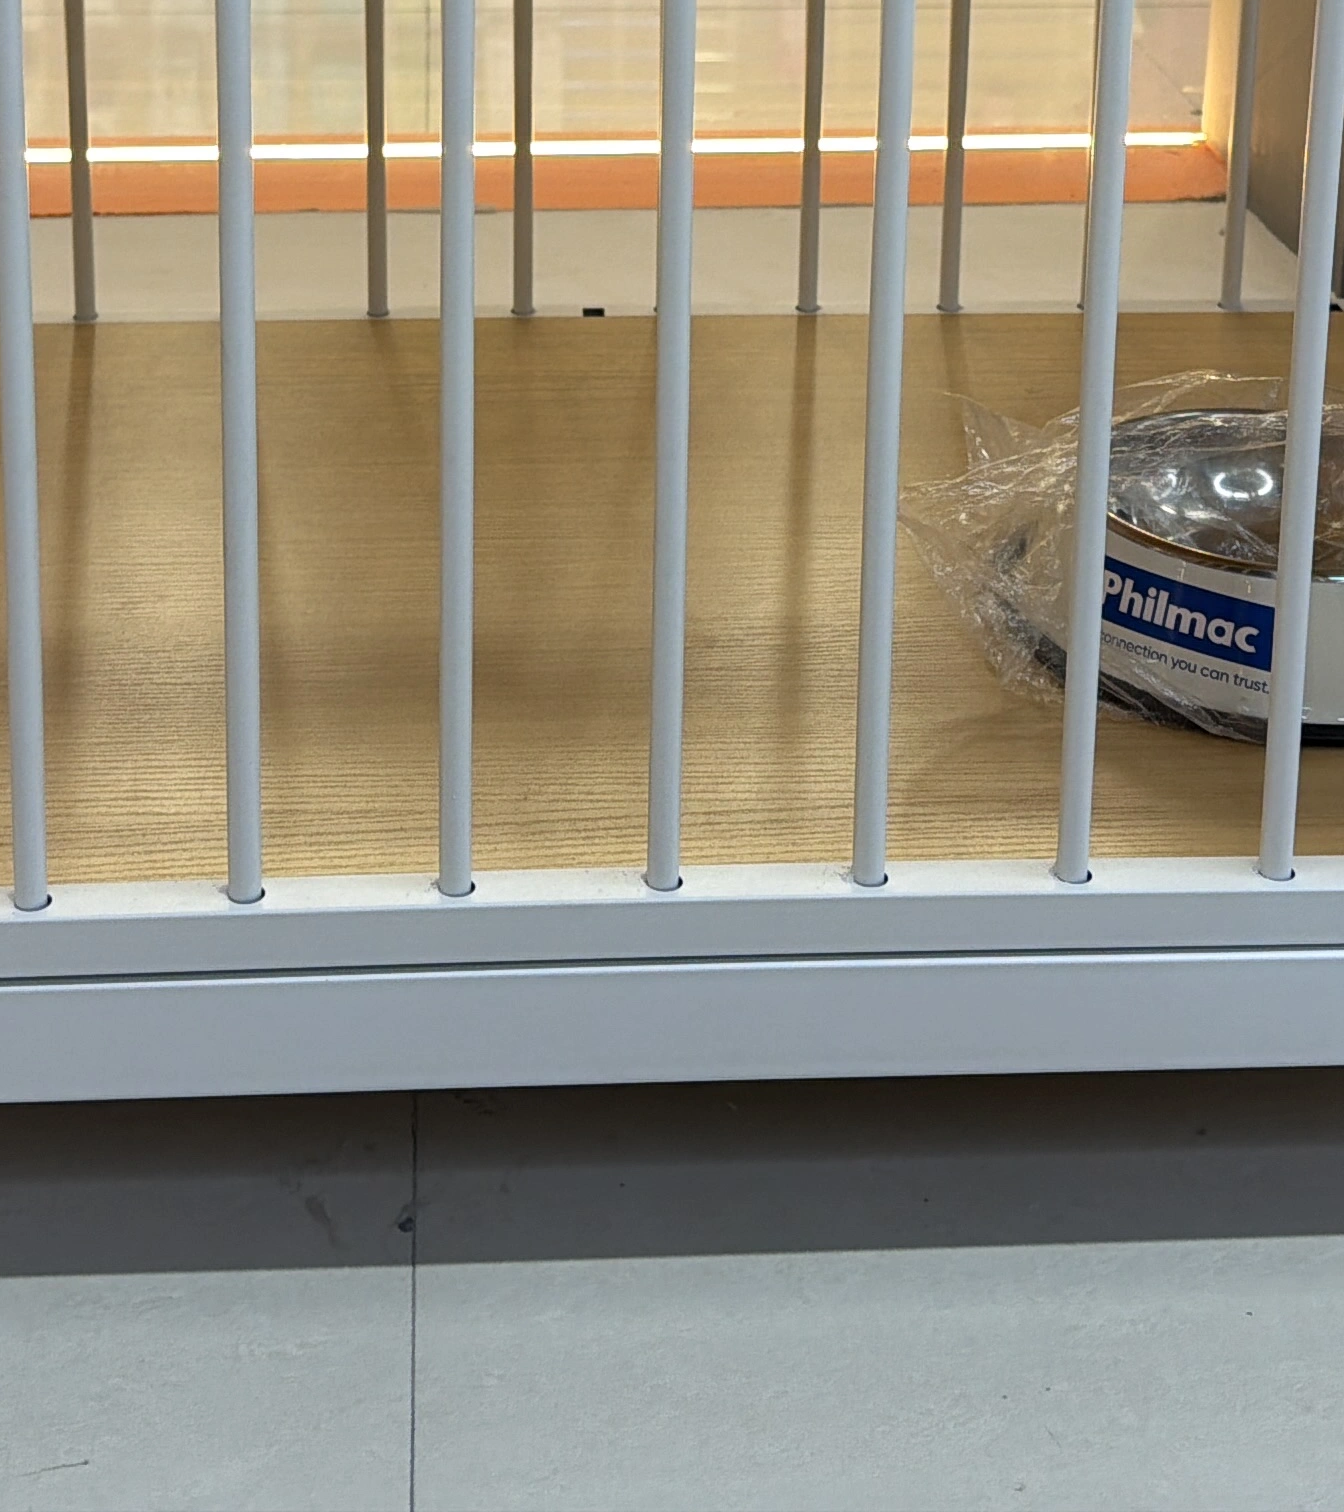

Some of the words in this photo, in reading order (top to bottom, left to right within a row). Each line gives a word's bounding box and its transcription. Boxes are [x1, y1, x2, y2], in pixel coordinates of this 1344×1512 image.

[1102, 569, 1260, 653] Philmac
[1170, 656, 1197, 674] you
[1200, 666, 1229, 683] can
[1233, 672, 1270, 694] trust.
